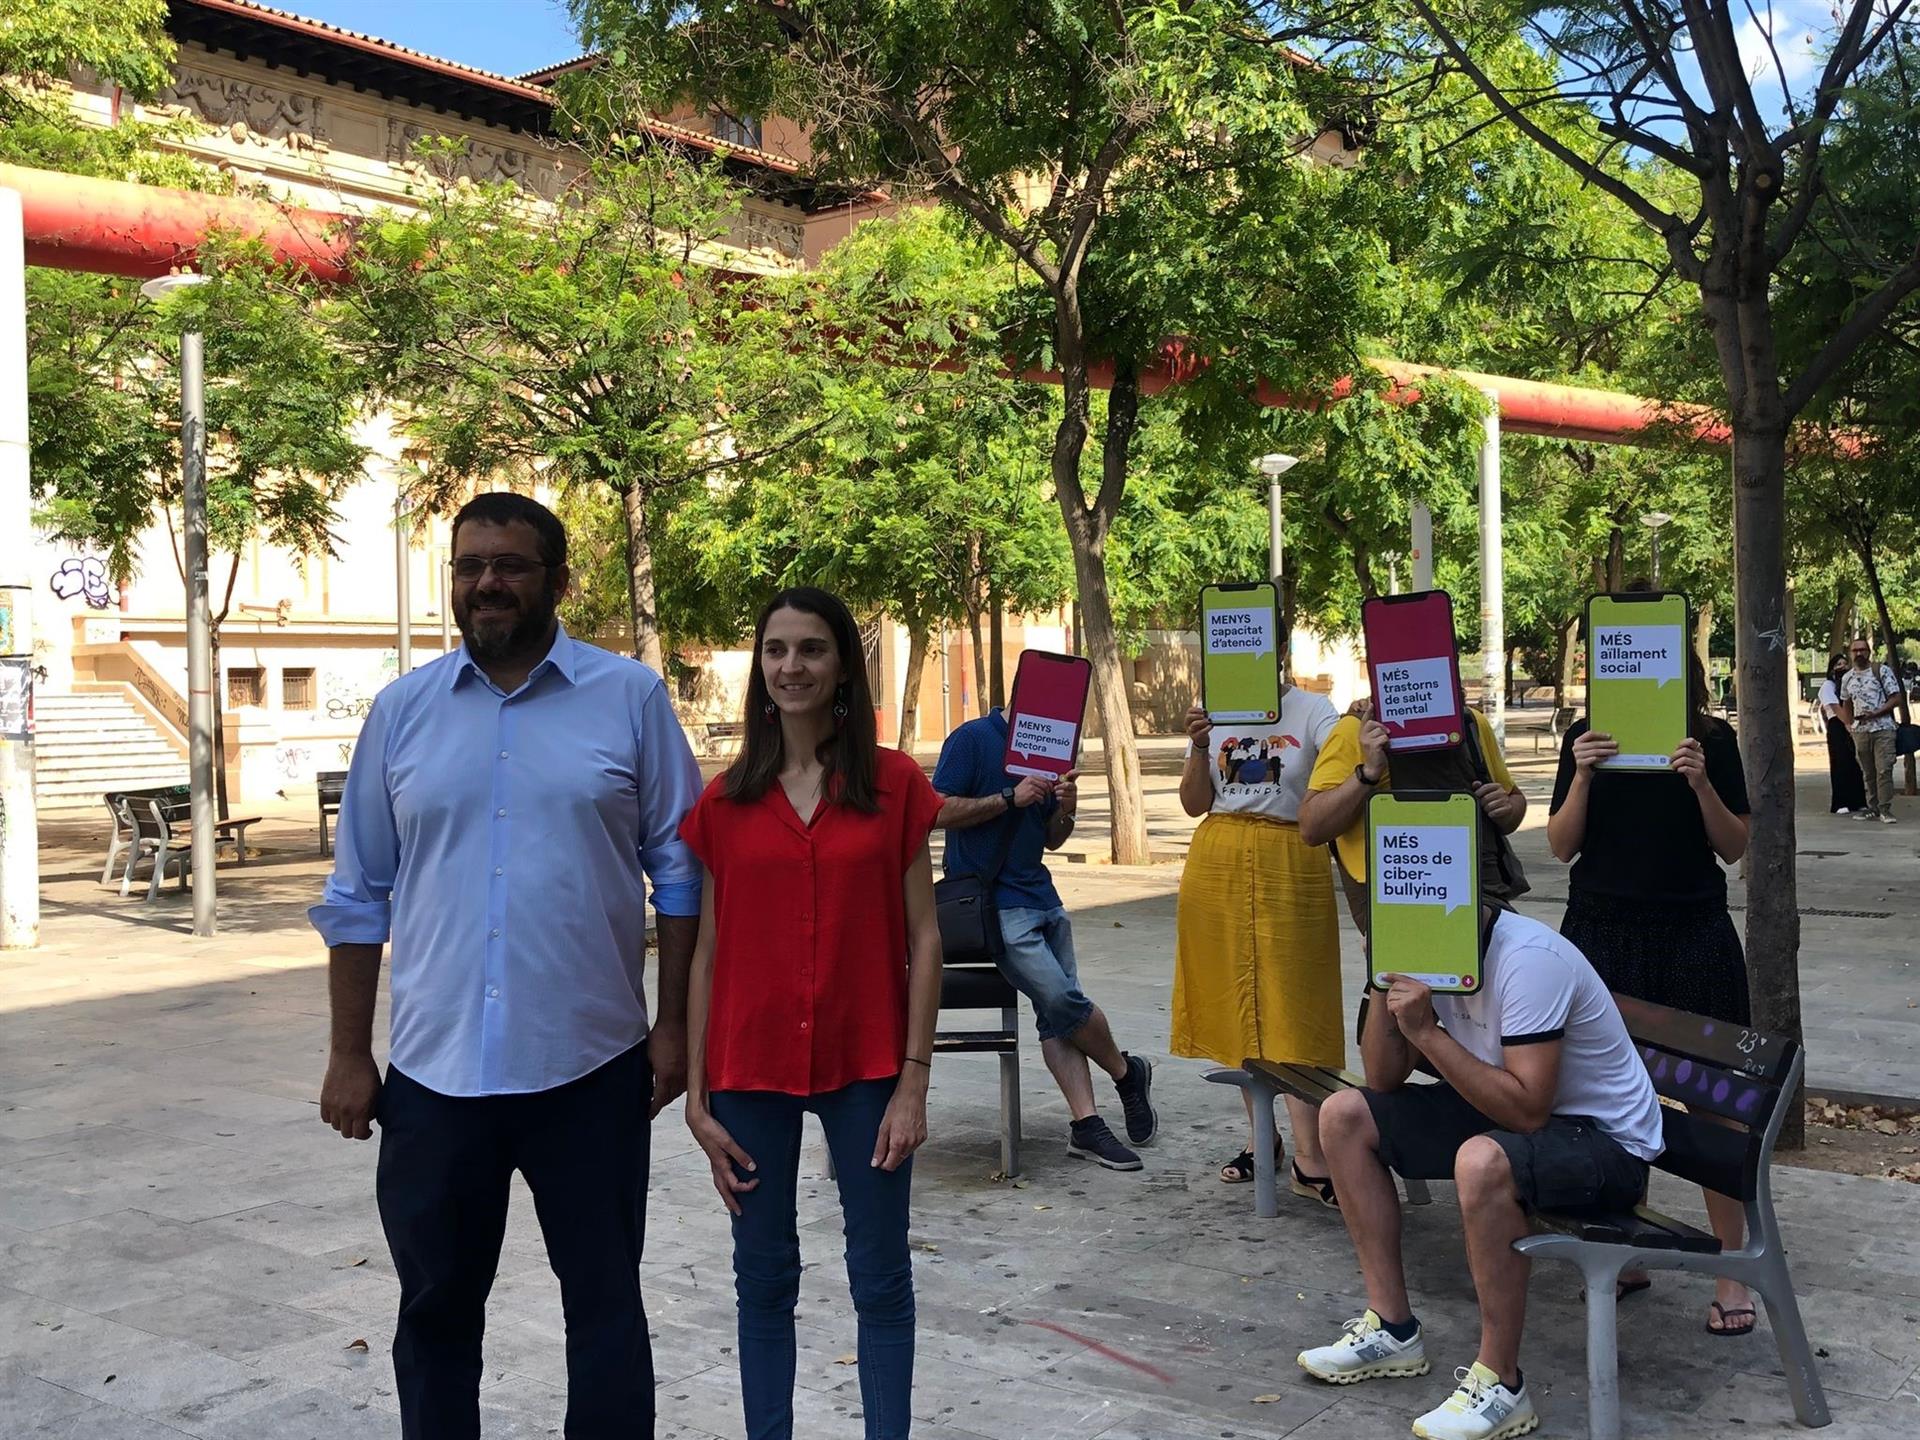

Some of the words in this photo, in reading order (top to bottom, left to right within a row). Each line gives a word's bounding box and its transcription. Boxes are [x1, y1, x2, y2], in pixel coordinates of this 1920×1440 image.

[1211, 614, 1251, 624] MENYS
[1211, 625, 1263, 638] capacitat
[1211, 637, 1262, 648] d'atenció
[1600, 631, 1632, 646] MÉS
[1600, 648, 1667, 659] aïllament
[1600, 661, 1641, 673] social
[1382, 668, 1410, 682] MÉS
[1383, 681, 1439, 693] trastorns
[1384, 694, 1400, 705] de
[1402, 692, 1433, 703] salut
[1386, 702, 1428, 716] mental
[1018, 720, 1052, 733] MENYS
[1014, 739, 1047, 752] lectora
[1016, 731, 1071, 747] comprensió
[1222, 786, 1281, 795] FRIENDS
[1383, 832, 1419, 848] MÉS
[1383, 854, 1428, 864] casos
[1432, 851, 1452, 864] de
[1383, 866, 1432, 880] ciber-
[1384, 882, 1447, 900] bullying
[1736, 1030, 1759, 1053] 23
